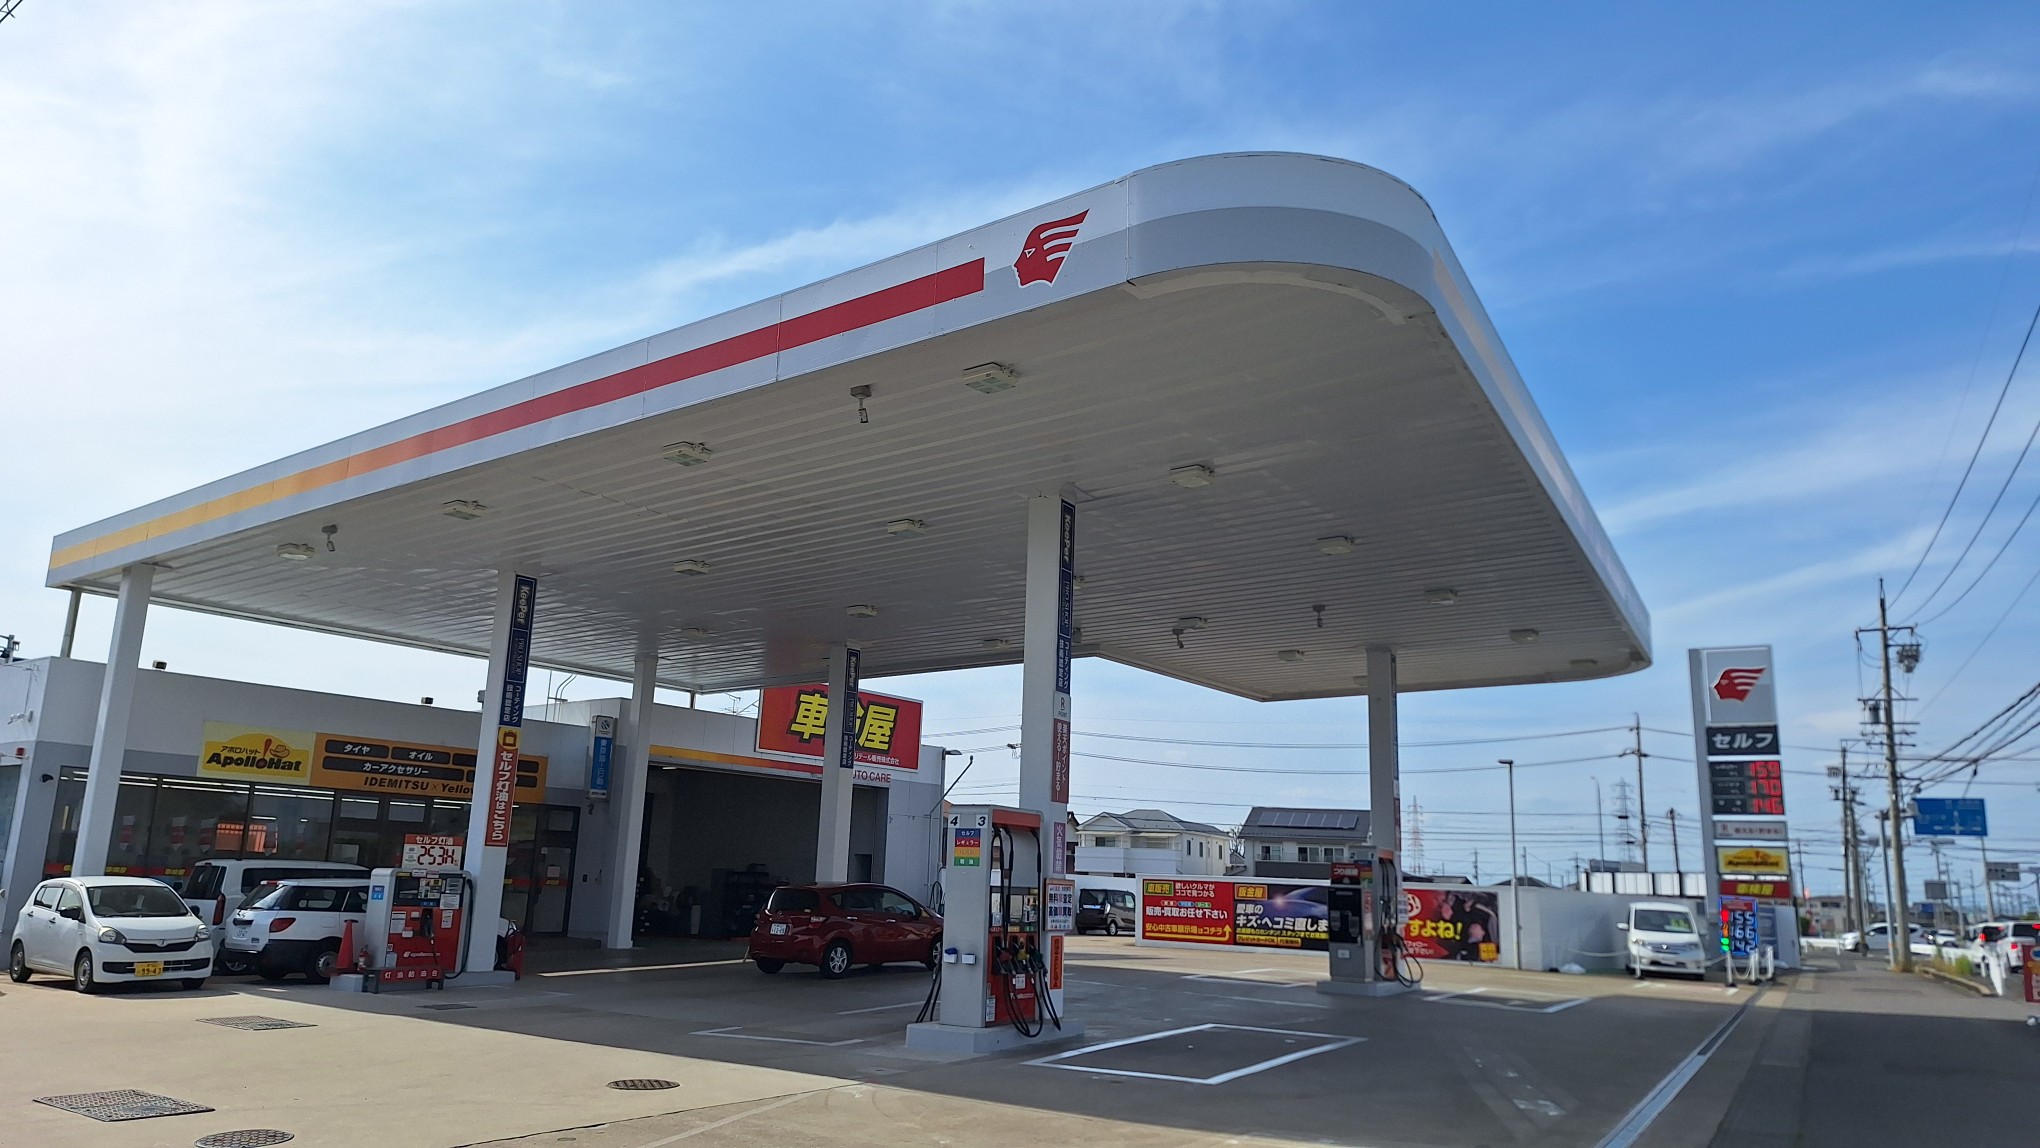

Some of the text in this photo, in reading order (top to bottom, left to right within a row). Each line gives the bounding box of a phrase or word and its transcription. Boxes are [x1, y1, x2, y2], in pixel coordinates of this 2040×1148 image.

[518, 586, 529, 625] KeePer
[512, 685, 521, 723] コーティング
[1712, 732, 1774, 749] セルフ
[220, 745, 261, 755] アポロハット
[343, 743, 371, 755] タイヤ
[408, 750, 434, 762] オイル
[206, 752, 302, 772] ApolloHat
[362, 762, 429, 775] カーアクセサリー
[1749, 760, 1780, 779] 159
[363, 776, 430, 791] IDEMITSU
[869, 771, 892, 783] CARE
[1750, 779, 1782, 796] 170
[492, 750, 514, 841] セルフ灯油はこちら
[1753, 797, 1784, 814] 146
[950, 815, 987, 827] 4 3
[415, 835, 454, 846] セルフ灯油
[1175, 882, 1215, 890] 欲しいクルマが
[1175, 889, 1215, 897] ココで見つかる
[1236, 903, 1264, 915] 愛車の
[1730, 910, 1755, 925] 155
[1731, 924, 1755, 939] 166
